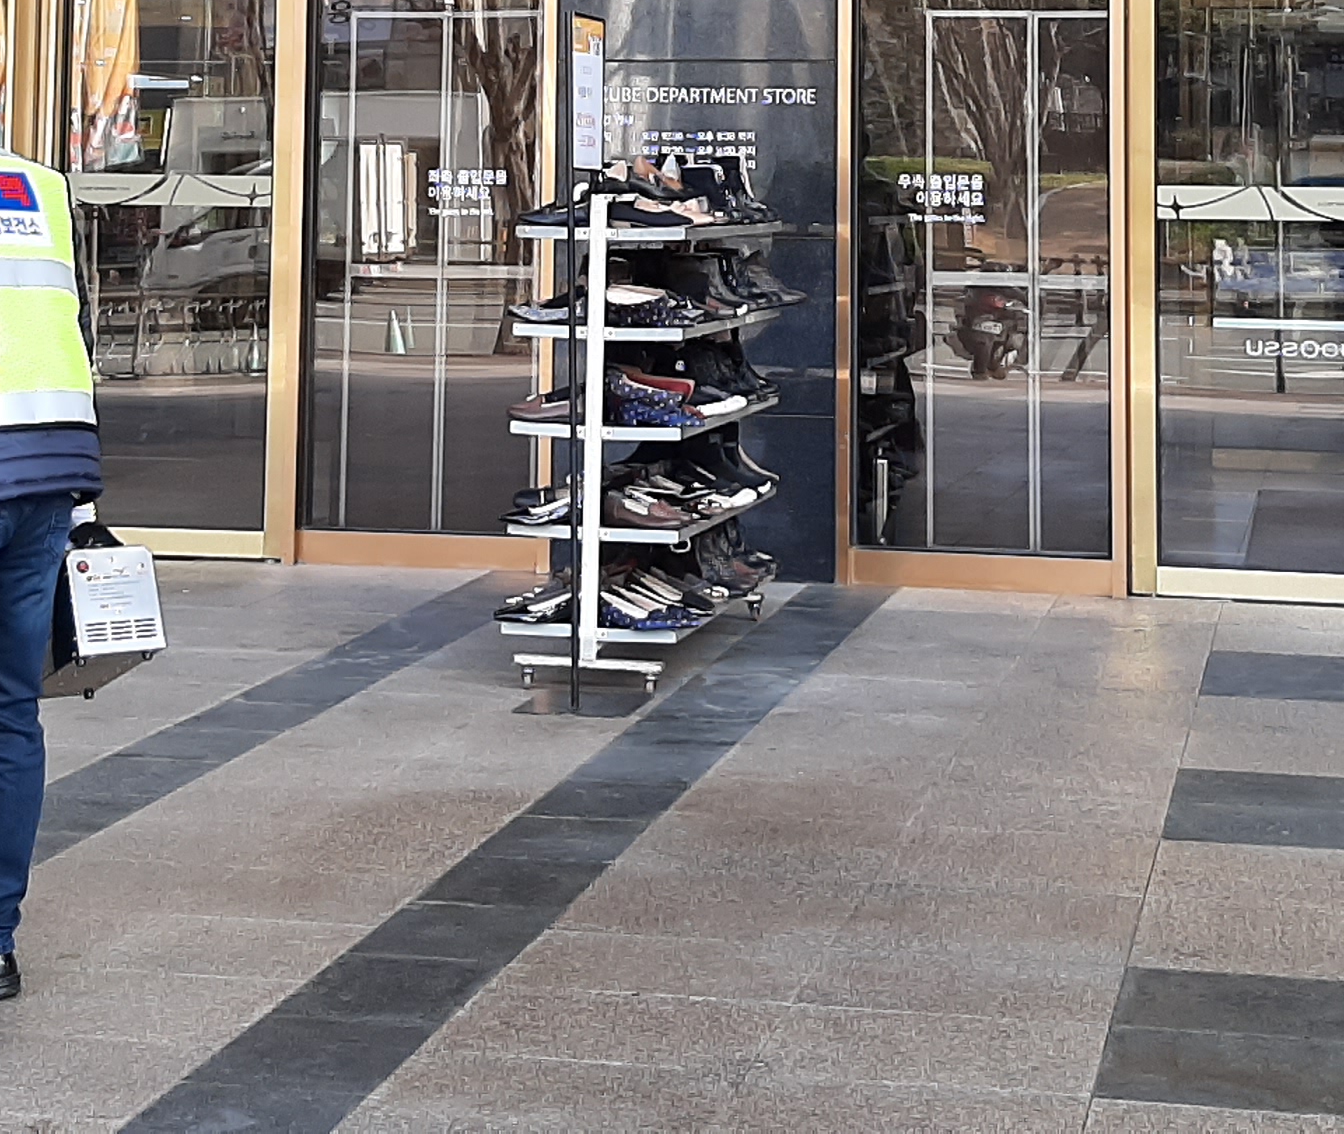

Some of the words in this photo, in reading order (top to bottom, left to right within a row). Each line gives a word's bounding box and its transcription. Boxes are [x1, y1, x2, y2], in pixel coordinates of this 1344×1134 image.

[646, 86, 758, 104] DEPARTMENT
[761, 88, 816, 104] STORE
[916, 191, 985, 207] 이용하세요
